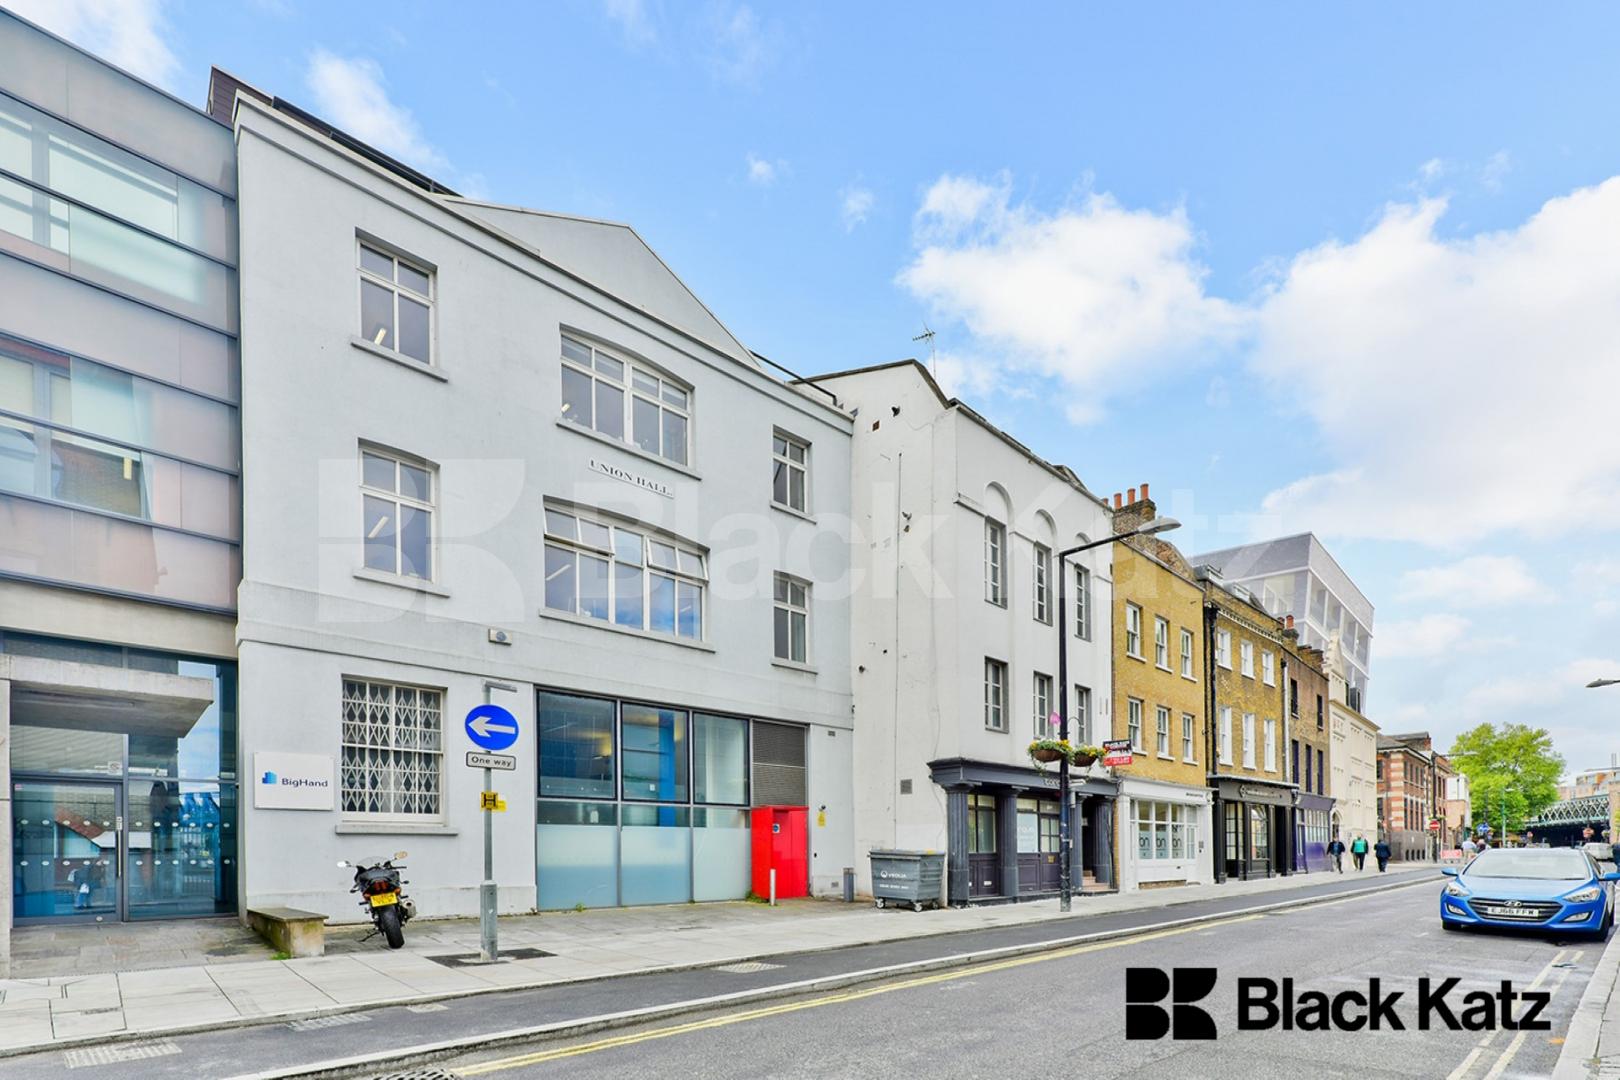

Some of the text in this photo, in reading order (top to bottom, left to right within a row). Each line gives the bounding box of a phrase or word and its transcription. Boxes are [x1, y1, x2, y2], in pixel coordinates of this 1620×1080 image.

[589, 460, 633, 482] UNION
[471, 756, 512, 768] One way
[281, 778, 328, 788] BigHand
